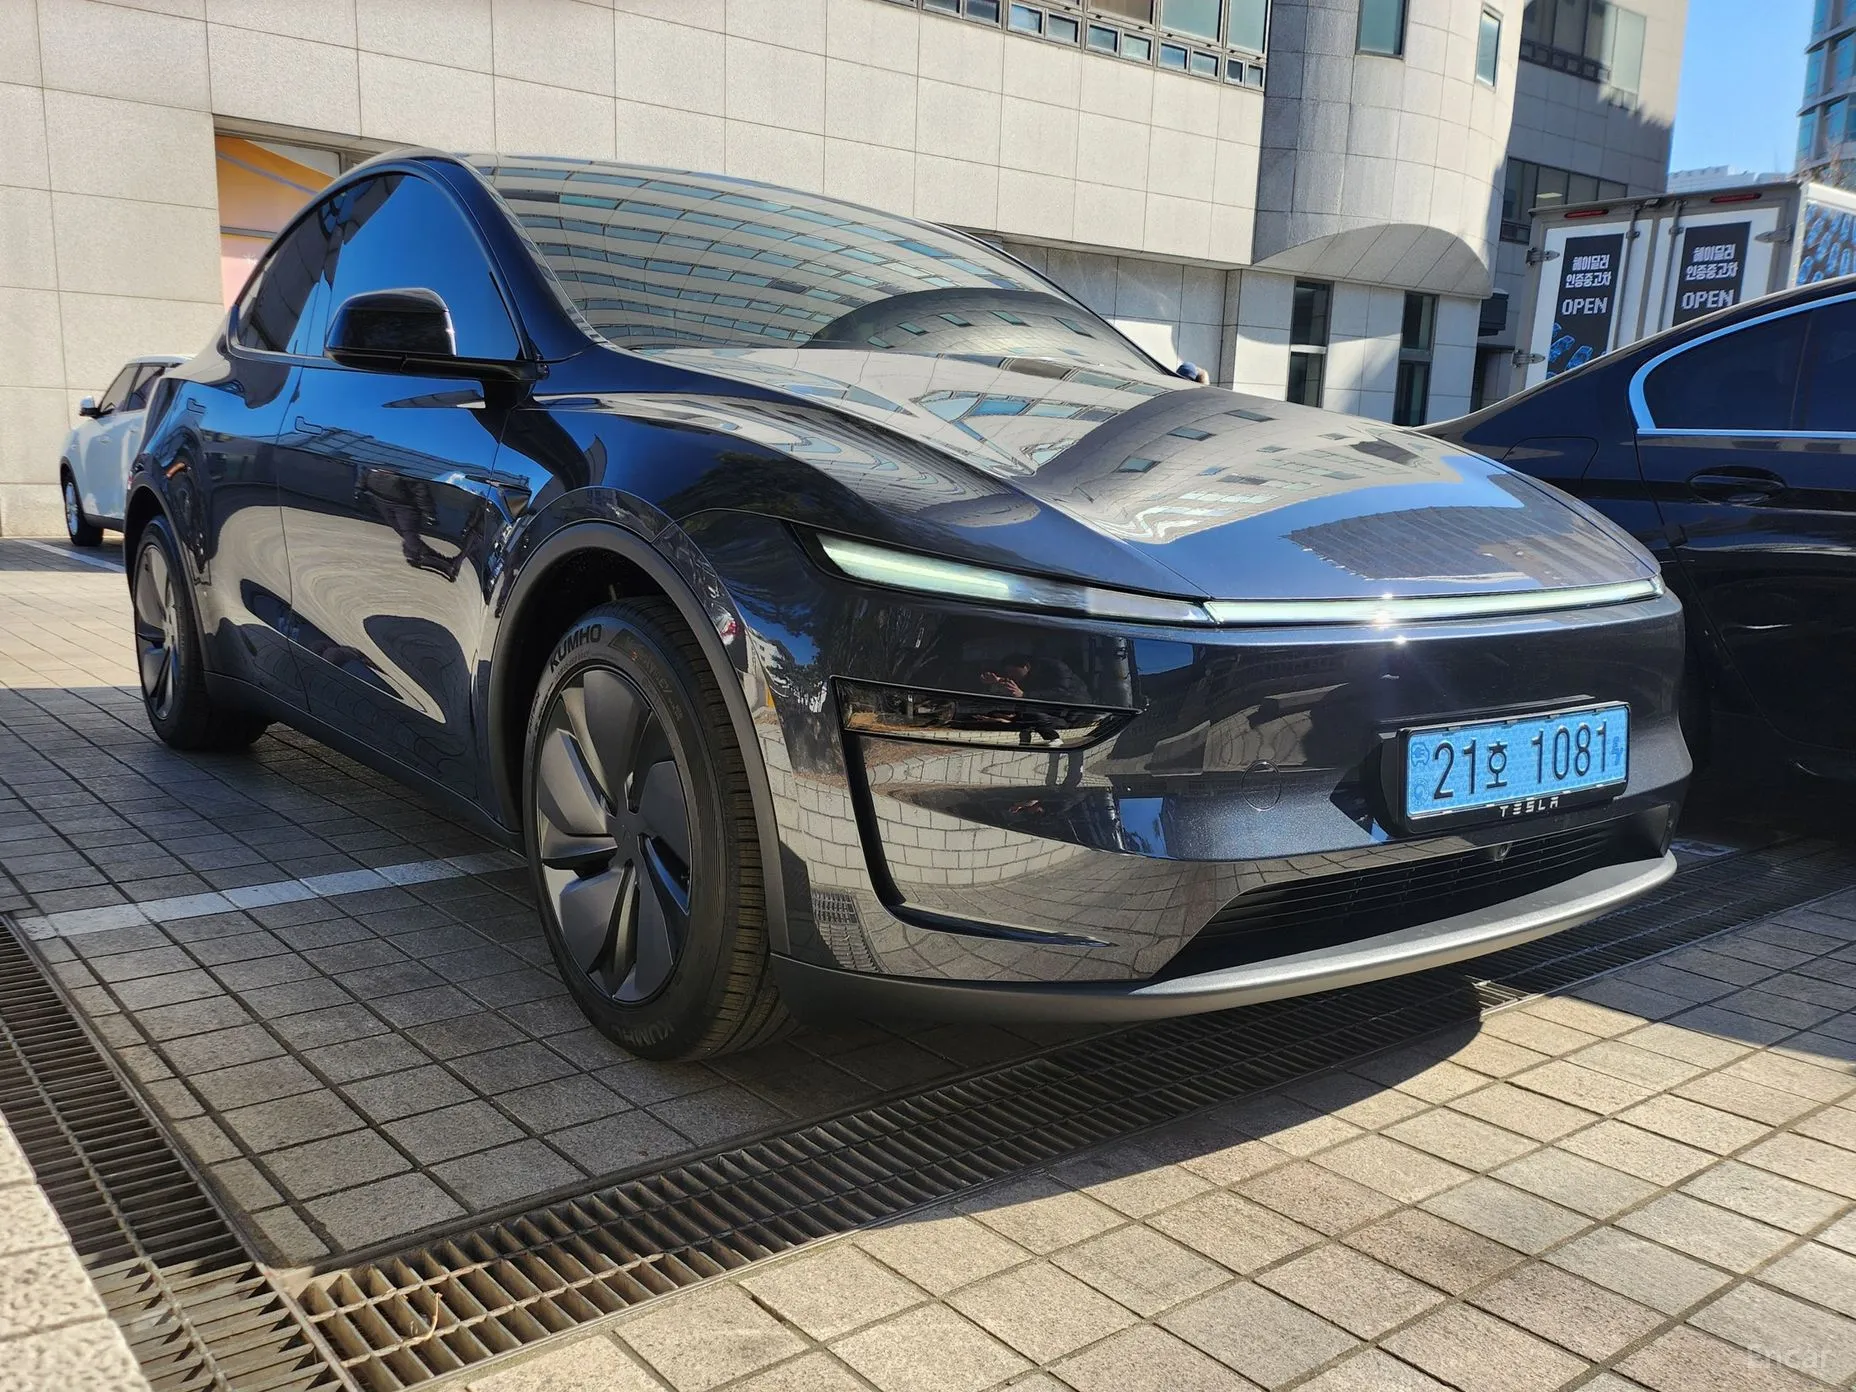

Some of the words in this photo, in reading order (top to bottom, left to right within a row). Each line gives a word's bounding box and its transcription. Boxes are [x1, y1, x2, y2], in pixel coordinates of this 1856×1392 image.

[1572, 254, 1610, 271] 헤이딜러
[1692, 243, 1737, 262] 헤이딜러
[1565, 271, 1612, 289] 인증중고차
[1685, 261, 1739, 281] 인증중고차
[1561, 297, 1608, 315] OPEN
[1681, 288, 1735, 310] OPEN
[550, 623, 603, 674] KUMHO
[1432, 737, 1508, 800] 21호
[1531, 719, 1608, 784] 1081
[1499, 796, 1560, 818] TESLA
